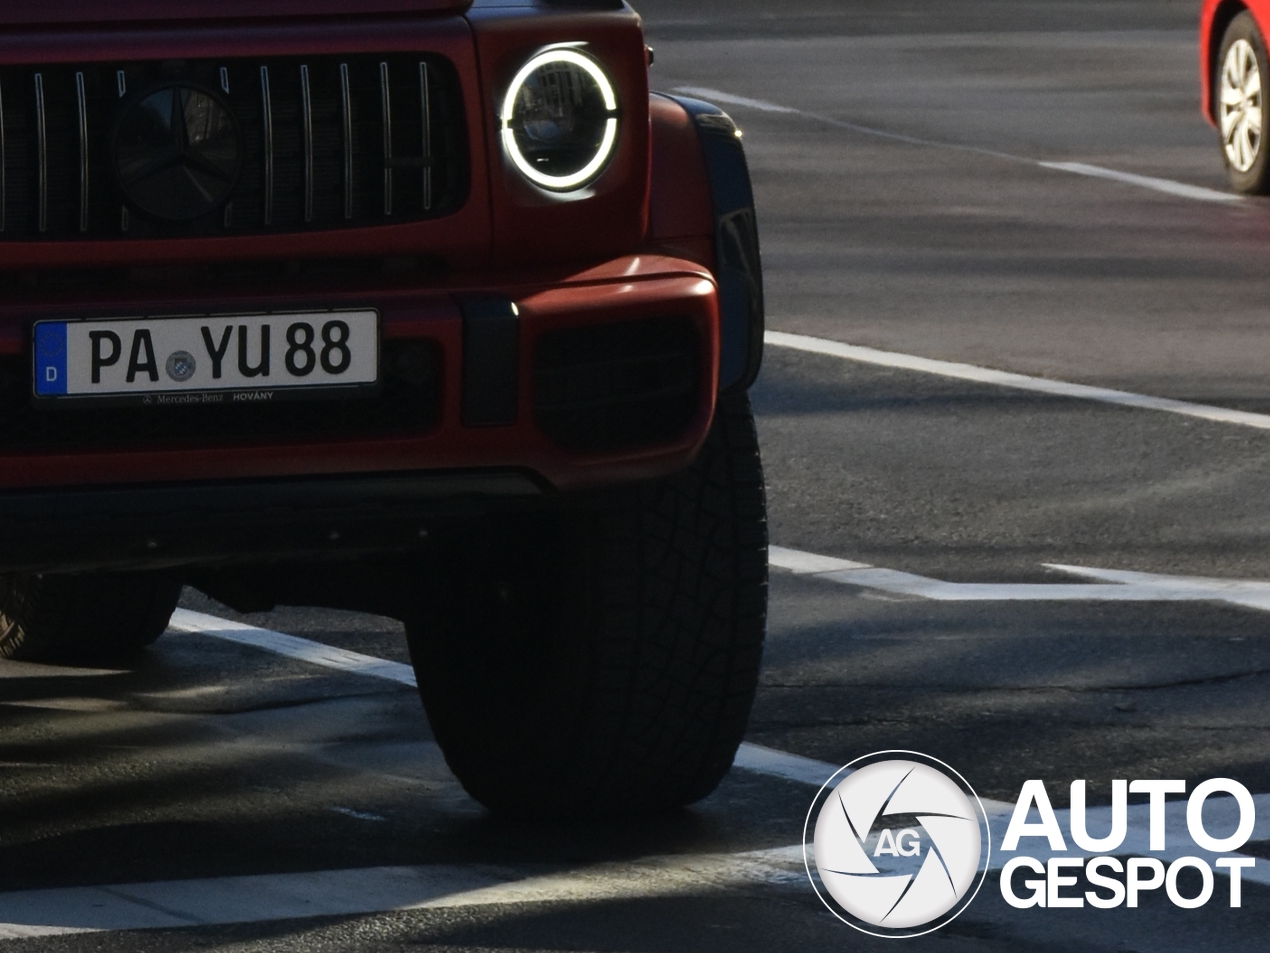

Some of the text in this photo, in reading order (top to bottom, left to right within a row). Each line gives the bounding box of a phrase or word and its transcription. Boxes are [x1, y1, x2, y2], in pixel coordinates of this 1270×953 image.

[88, 328, 159, 384] PA
[46, 366, 57, 382] D
[157, 390, 273, 404] Mercedes-Benz HOVÁNY
